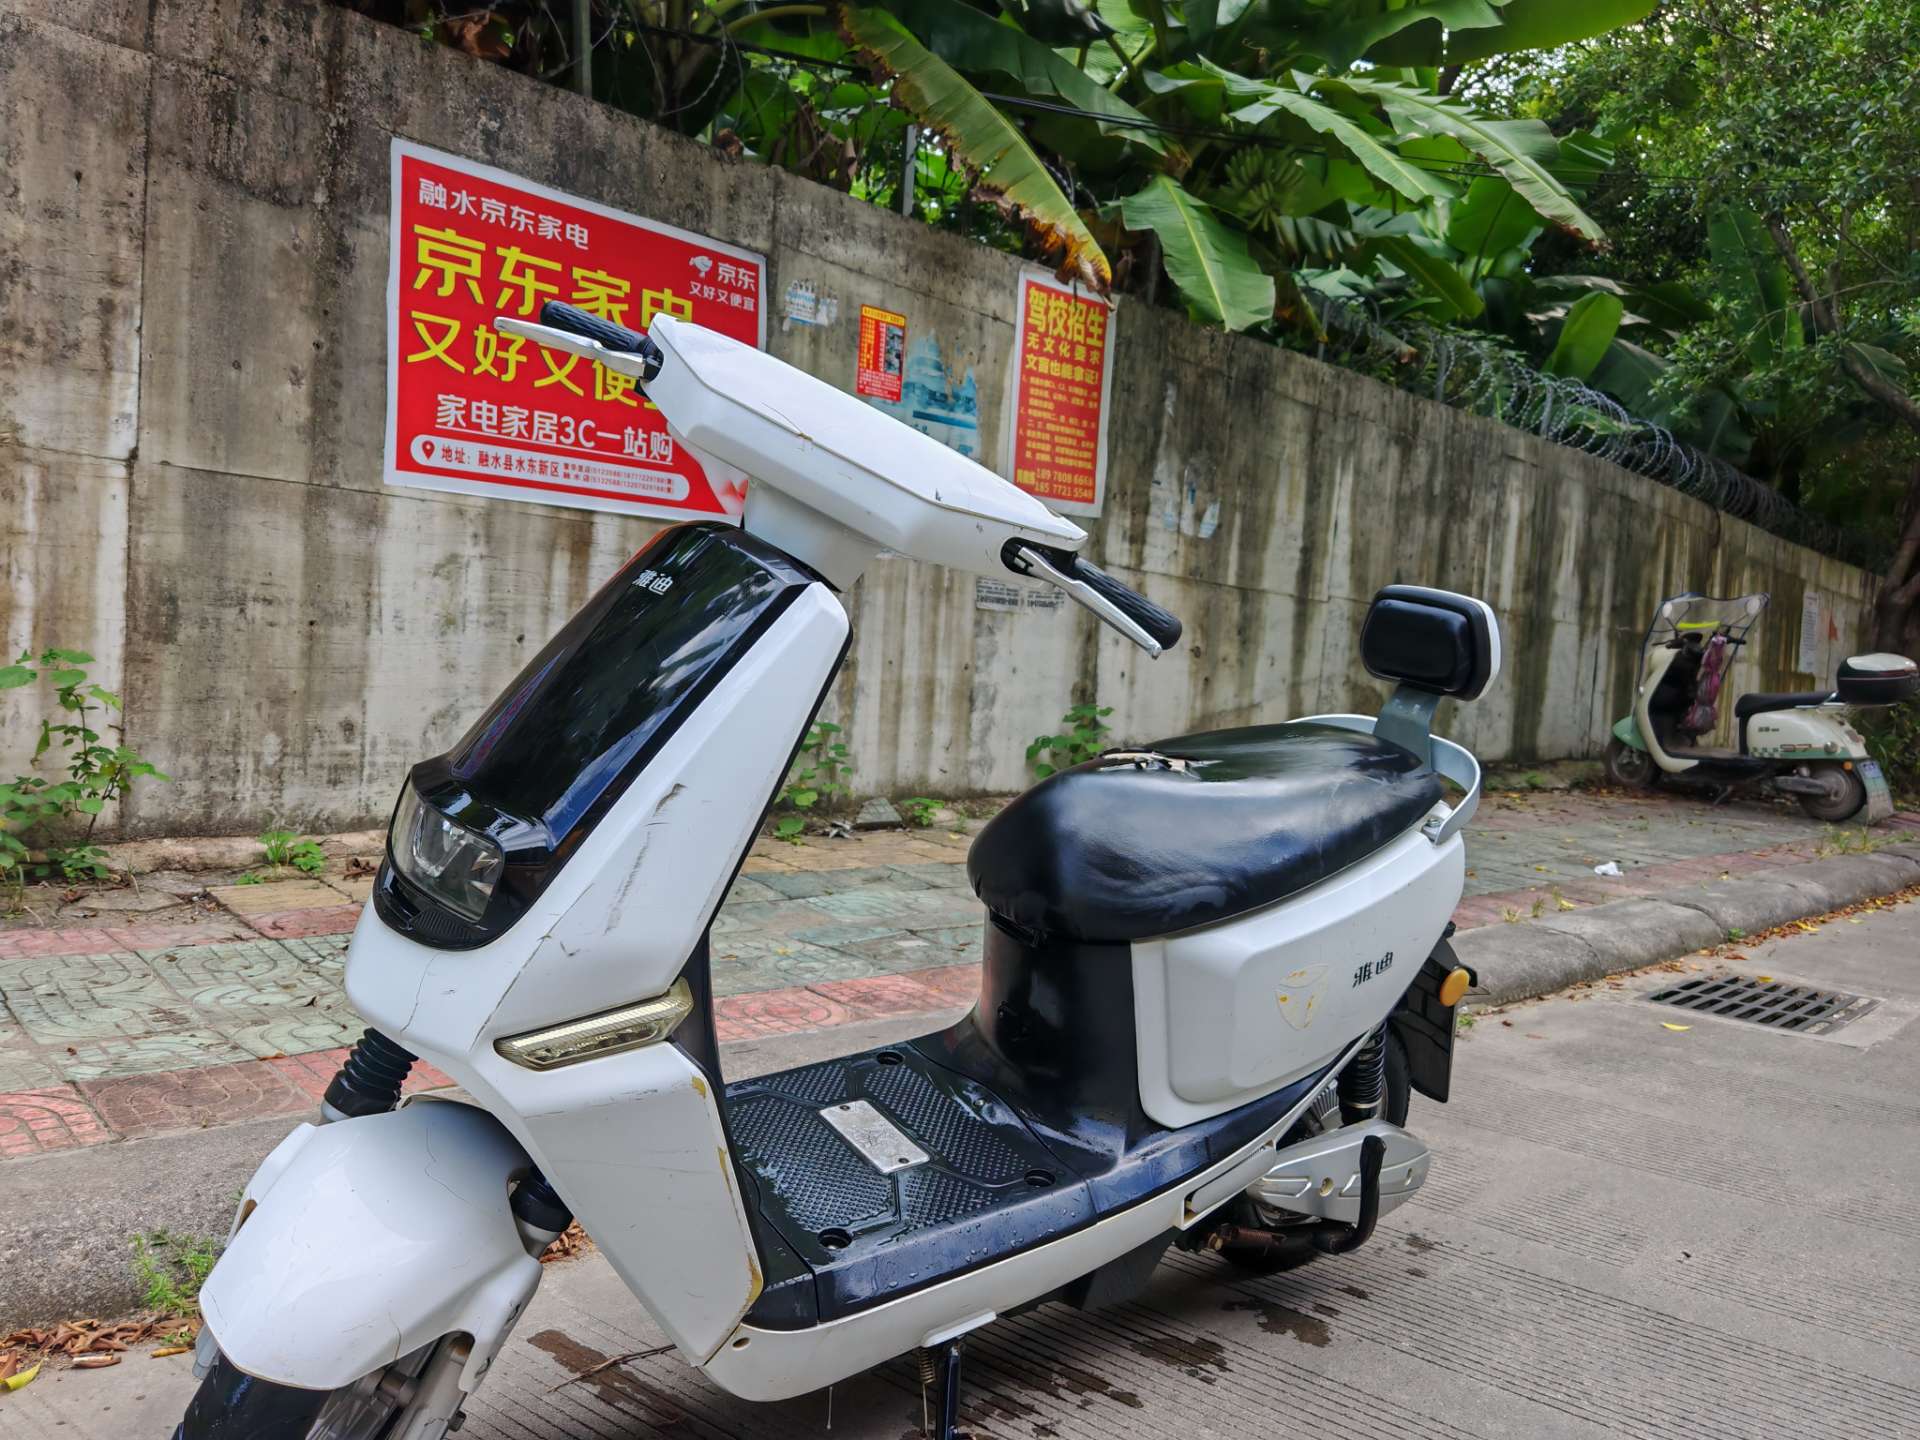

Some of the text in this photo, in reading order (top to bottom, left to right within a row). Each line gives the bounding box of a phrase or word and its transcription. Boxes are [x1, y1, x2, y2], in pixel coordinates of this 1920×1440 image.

[418, 178, 589, 250] 融水京东家电
[688, 281, 756, 312] 又好又便宜
[717, 261, 756, 291] 京东
[1027, 287, 1104, 348] 驾校招生
[407, 310, 658, 410] 又好又便
[435, 394, 674, 462] 家电家居3C一站购
[1352, 951, 1394, 989] 雅迪
